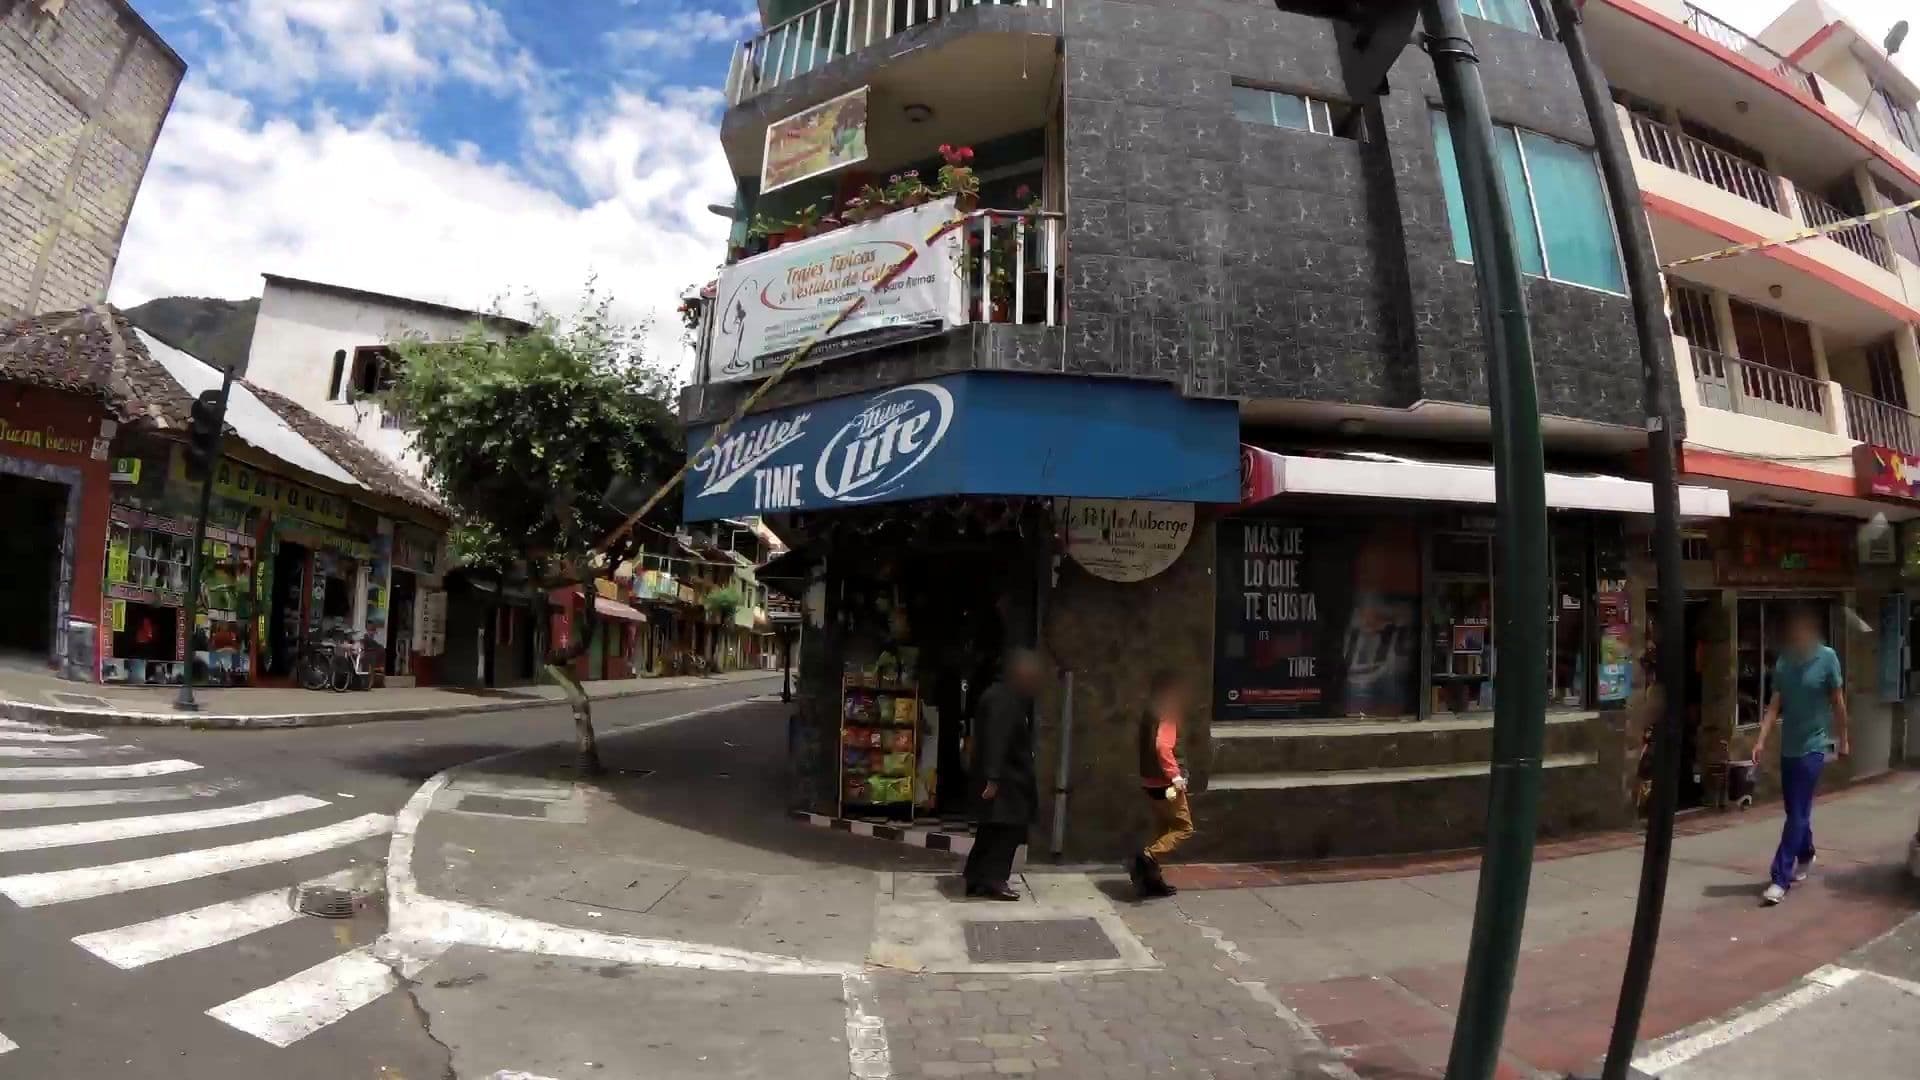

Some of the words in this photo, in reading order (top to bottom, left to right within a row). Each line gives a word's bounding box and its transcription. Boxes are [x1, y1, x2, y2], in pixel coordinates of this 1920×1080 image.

[849, 399, 915, 434] Miller
[693, 411, 812, 495] Miller
[835, 410, 932, 497] Lite
[1130, 508, 1188, 540] Auberge
[1243, 522, 1281, 555] MÁS
[1284, 527, 1305, 555] DE
[1243, 559, 1264, 588] LO
[1267, 559, 1300, 589] QUE
[1243, 591, 1264, 622] TE
[1267, 591, 1318, 622] GUSTA
[1288, 656, 1317, 678] TIME
